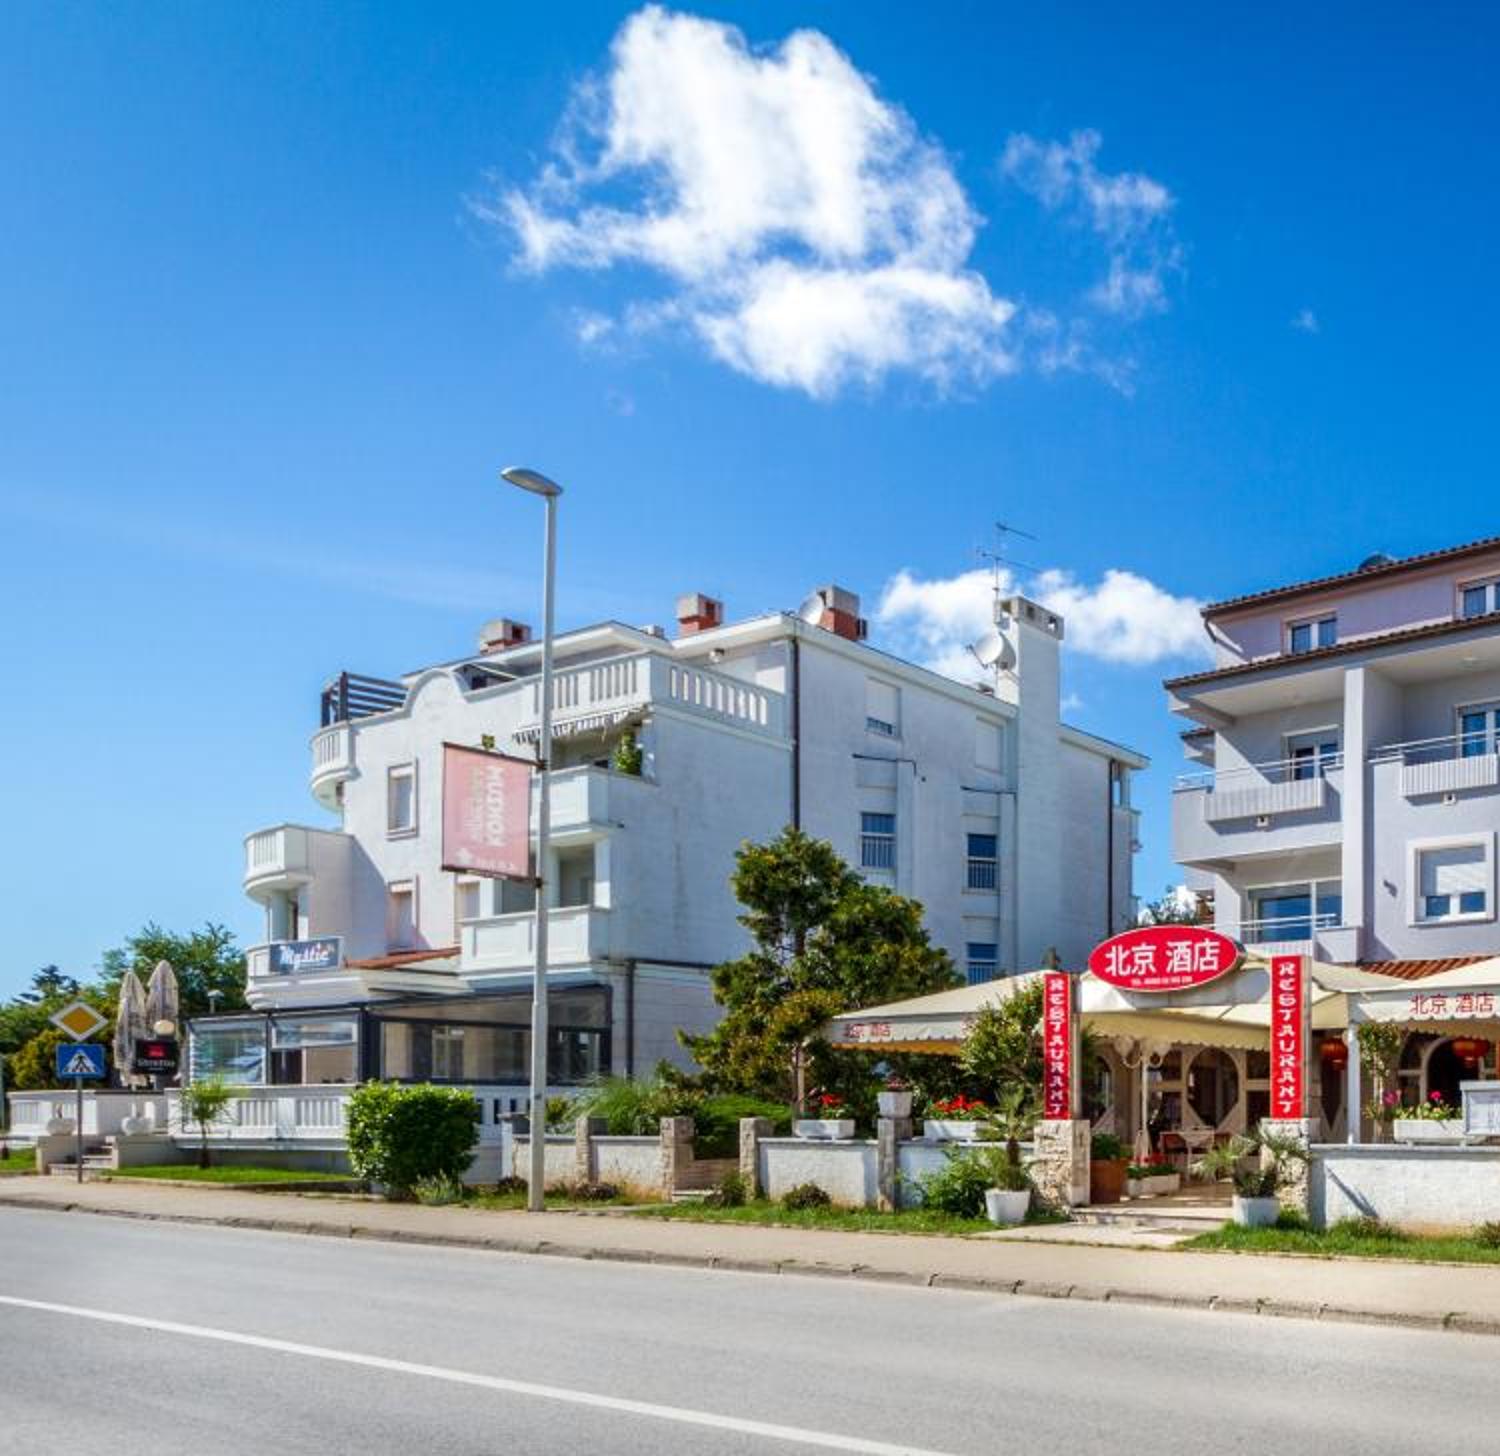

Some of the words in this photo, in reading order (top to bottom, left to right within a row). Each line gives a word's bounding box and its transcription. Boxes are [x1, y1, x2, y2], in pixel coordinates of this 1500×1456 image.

[1105, 944, 1157, 976] 北京
[1165, 938, 1220, 973] 酒店
[1048, 978, 1066, 1116] RESTAURANT
[1277, 961, 1297, 1114] RESTAURANT
[1410, 994, 1448, 1014] 北京
[1455, 992, 1495, 1013] 酒店
